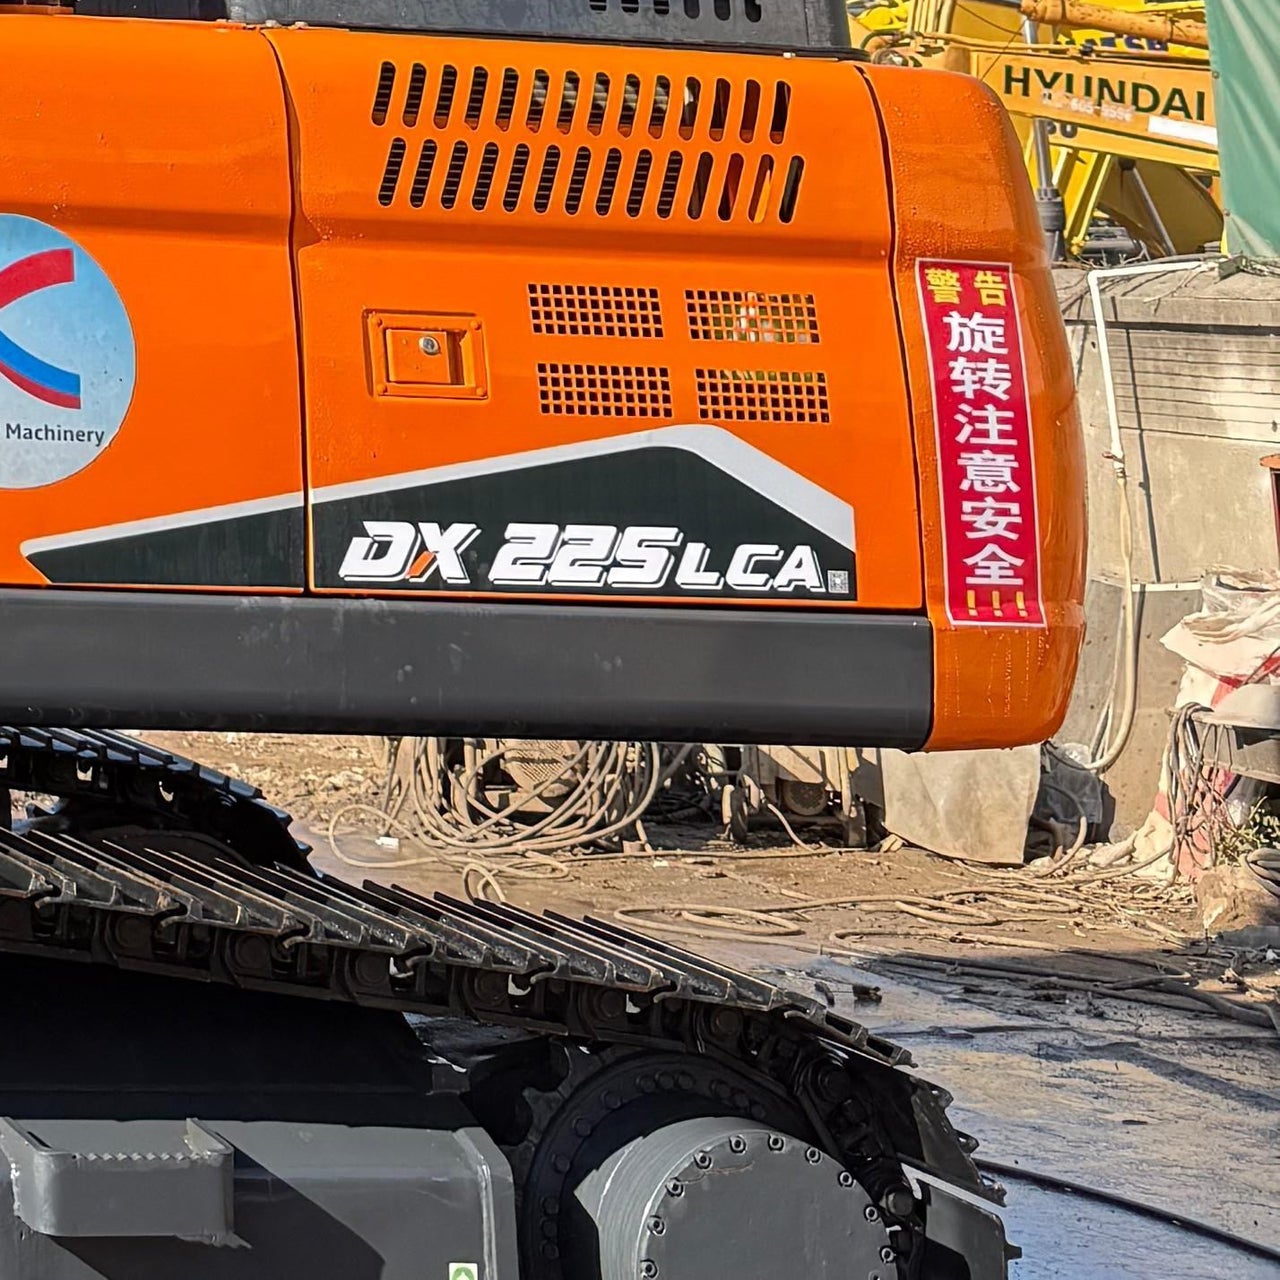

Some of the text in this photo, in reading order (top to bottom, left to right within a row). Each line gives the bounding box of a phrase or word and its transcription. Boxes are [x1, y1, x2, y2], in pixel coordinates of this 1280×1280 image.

[1003, 64, 1206, 121] HYUNDAI
[925, 268, 1008, 307] 警告
[6, 422, 105, 447] Machinery
[943, 311, 1025, 586] 旋转注意安全
[339, 520, 482, 583] DX
